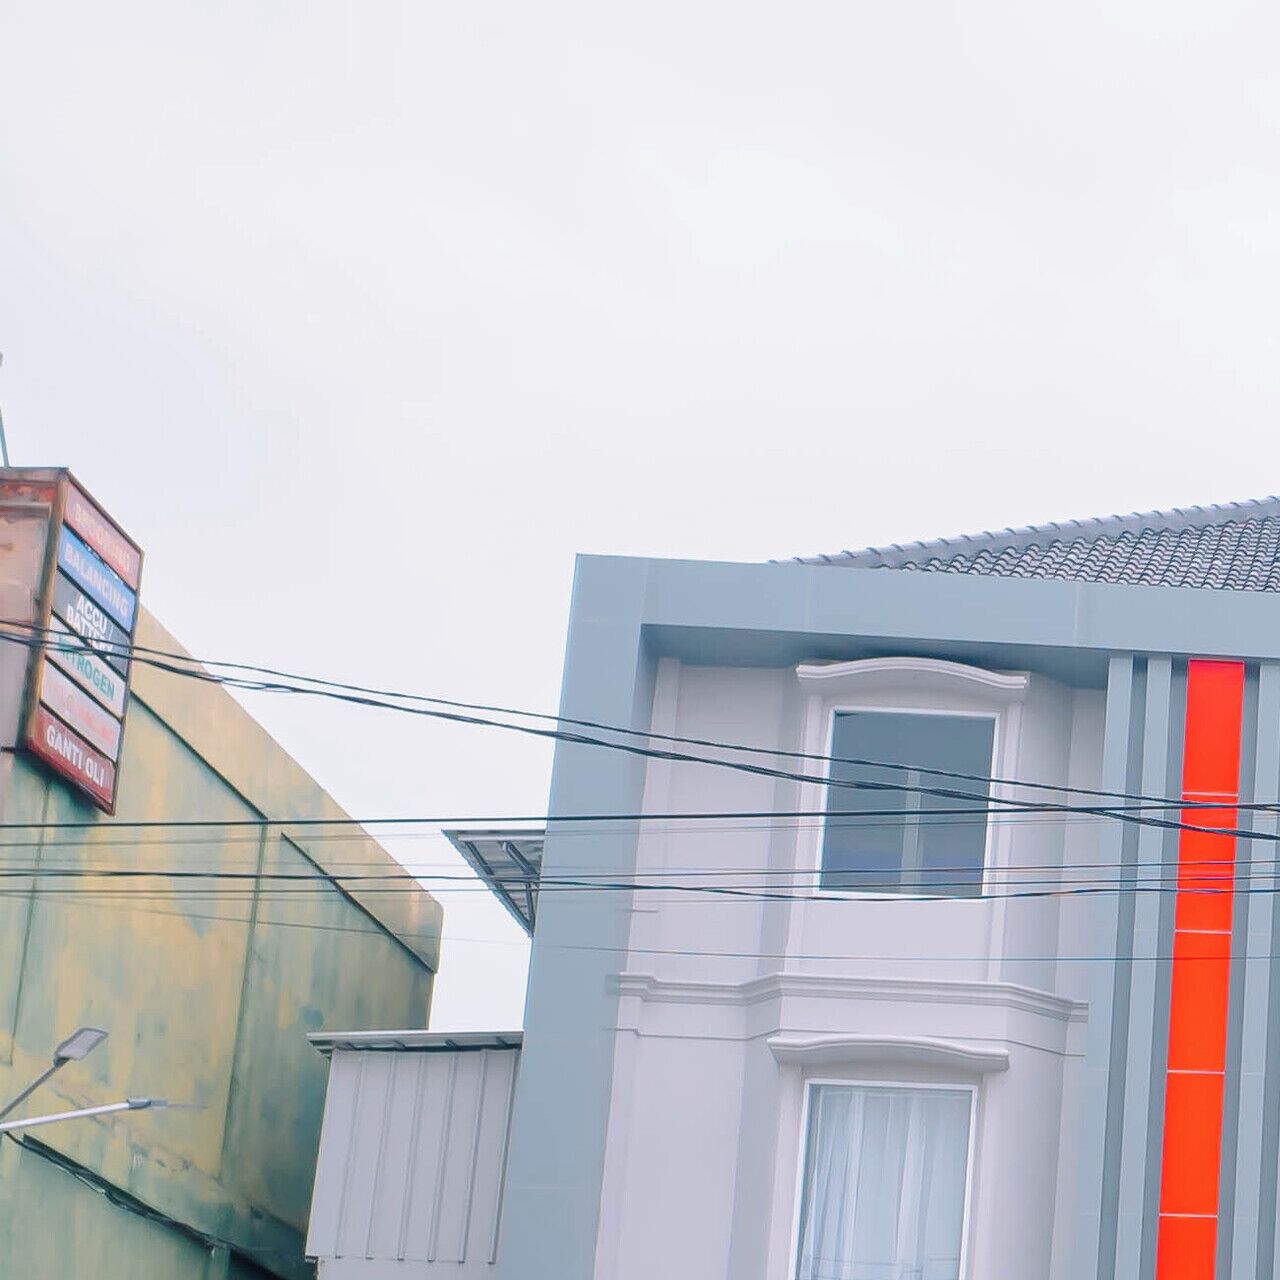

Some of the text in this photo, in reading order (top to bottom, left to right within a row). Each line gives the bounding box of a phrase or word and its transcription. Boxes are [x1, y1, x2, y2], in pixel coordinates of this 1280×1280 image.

[64, 543, 129, 618] BALANCING
[76, 595, 107, 634] ACCU
[46, 723, 105, 788] GANTI OLI
